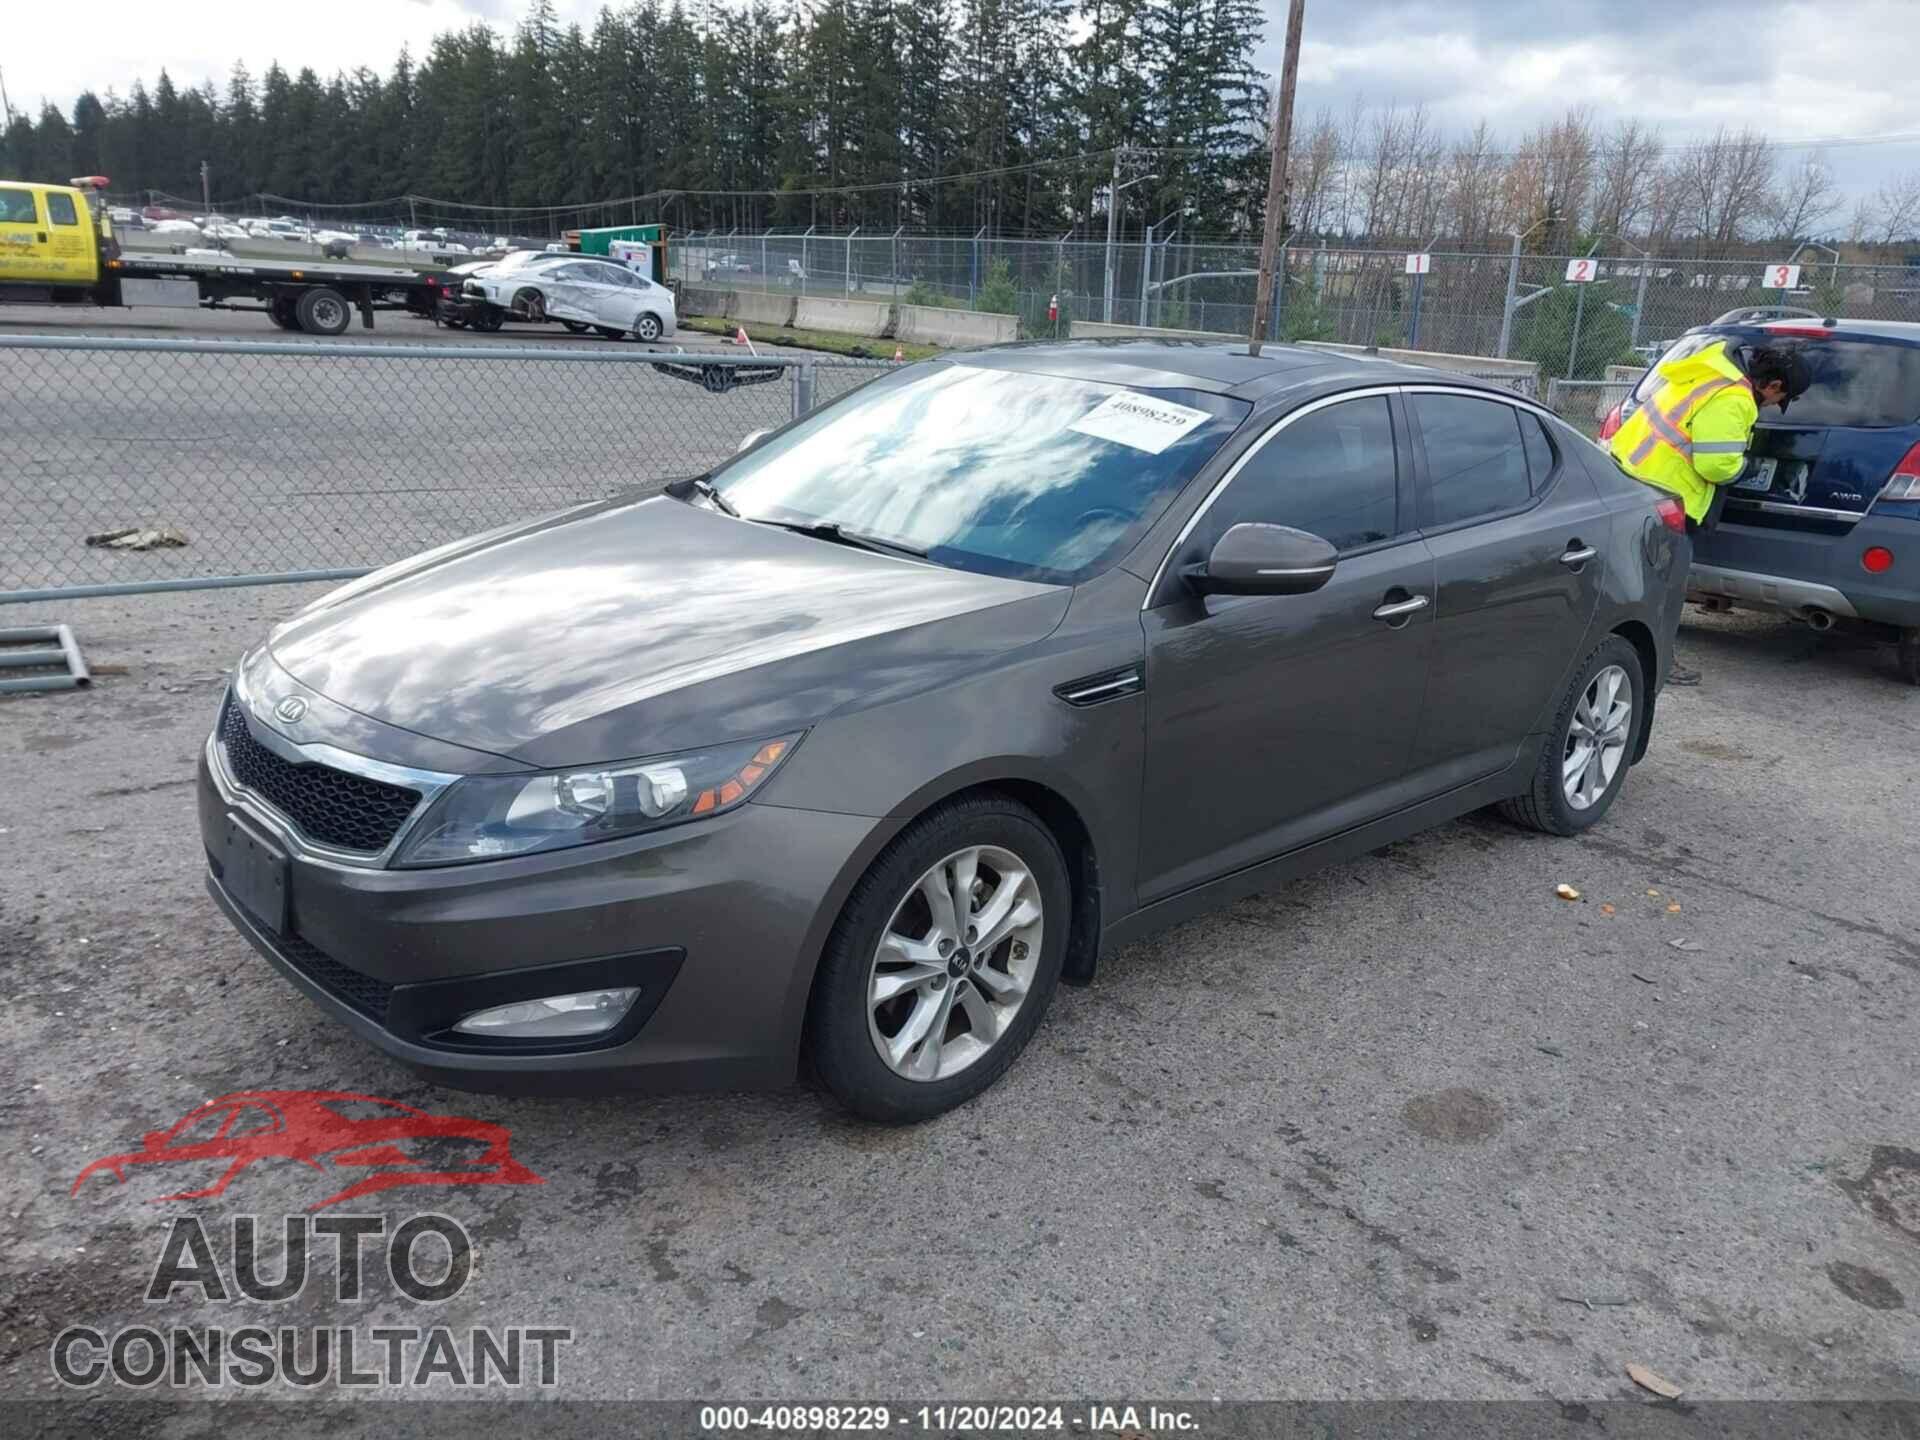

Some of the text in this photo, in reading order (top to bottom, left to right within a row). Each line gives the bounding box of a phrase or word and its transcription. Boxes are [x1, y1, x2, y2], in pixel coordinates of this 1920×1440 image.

[1415, 255, 1421, 273] 1
[1575, 260, 1588, 280] 2
[1774, 265, 1789, 288] 3
[1830, 491, 1862, 501] AWD
[277, 699, 304, 720] KIA
